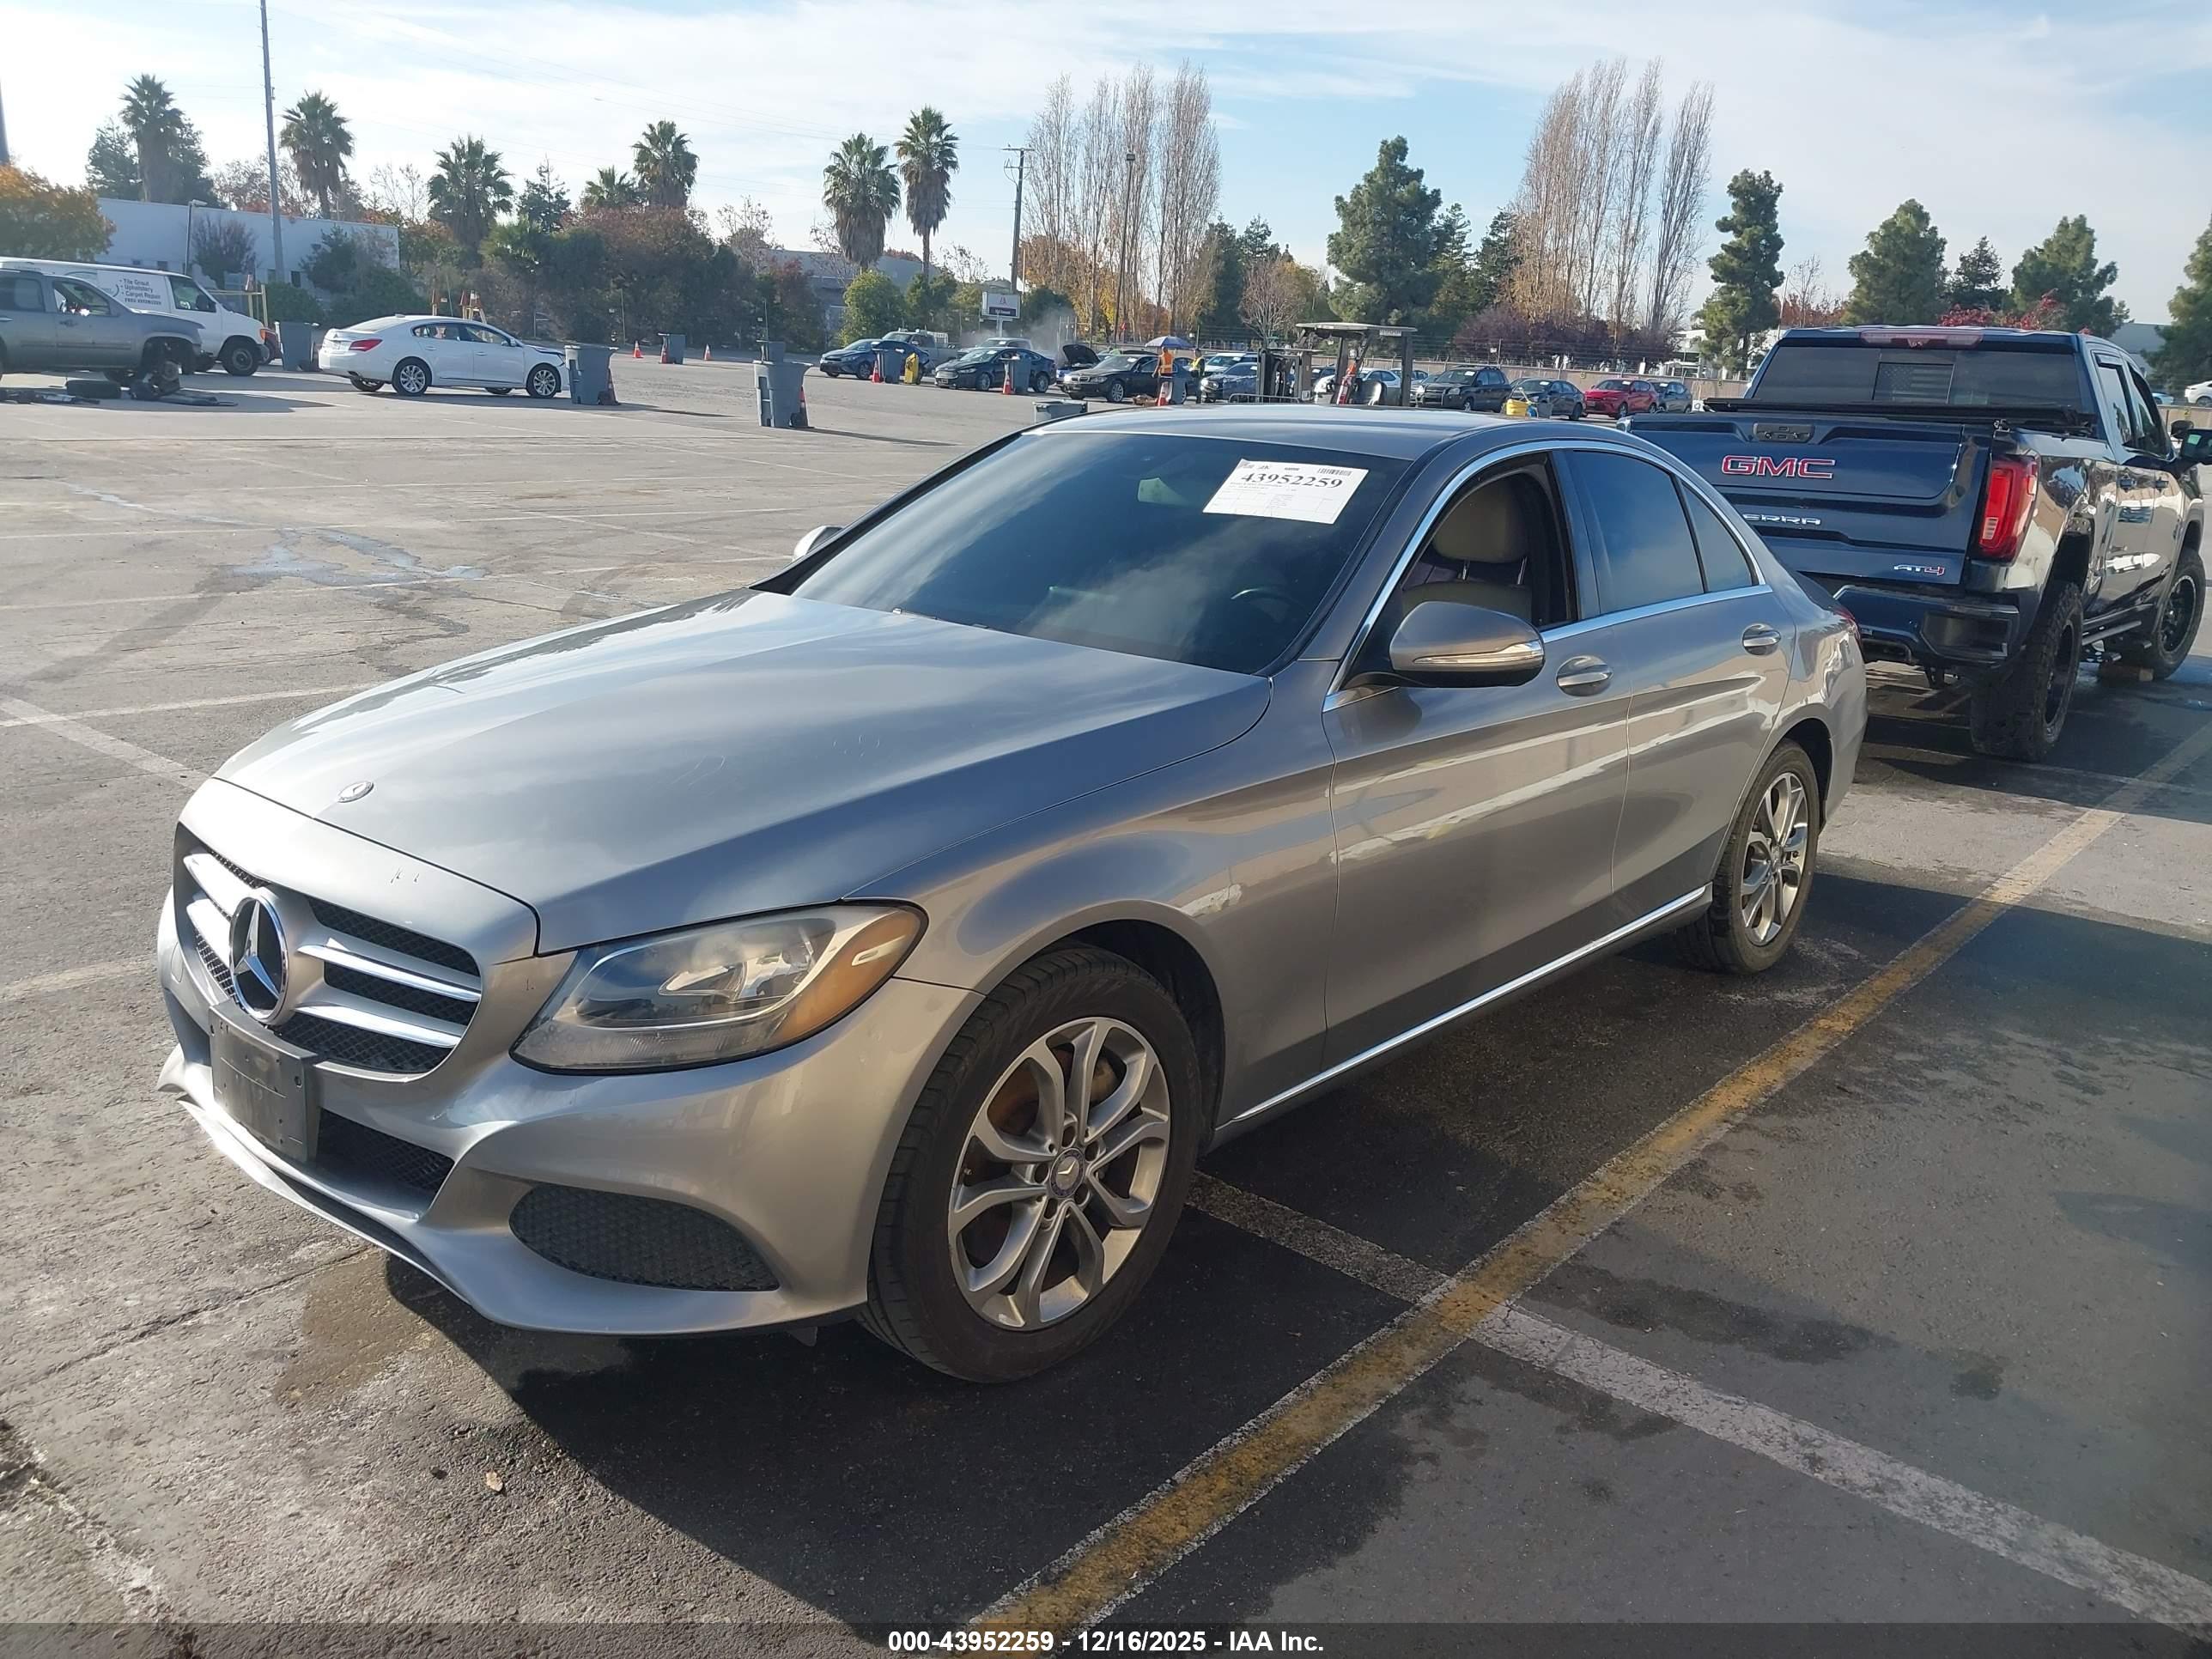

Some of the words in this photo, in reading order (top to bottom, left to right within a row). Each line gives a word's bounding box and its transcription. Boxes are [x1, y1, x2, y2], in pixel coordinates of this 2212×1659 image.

[125, 284, 153, 293] Upholstery
[1722, 455, 1835, 478] GMC
[1242, 472, 1343, 489] 43952259
[1742, 514, 1820, 525] ERRA
[1893, 564, 1945, 576] AT4
